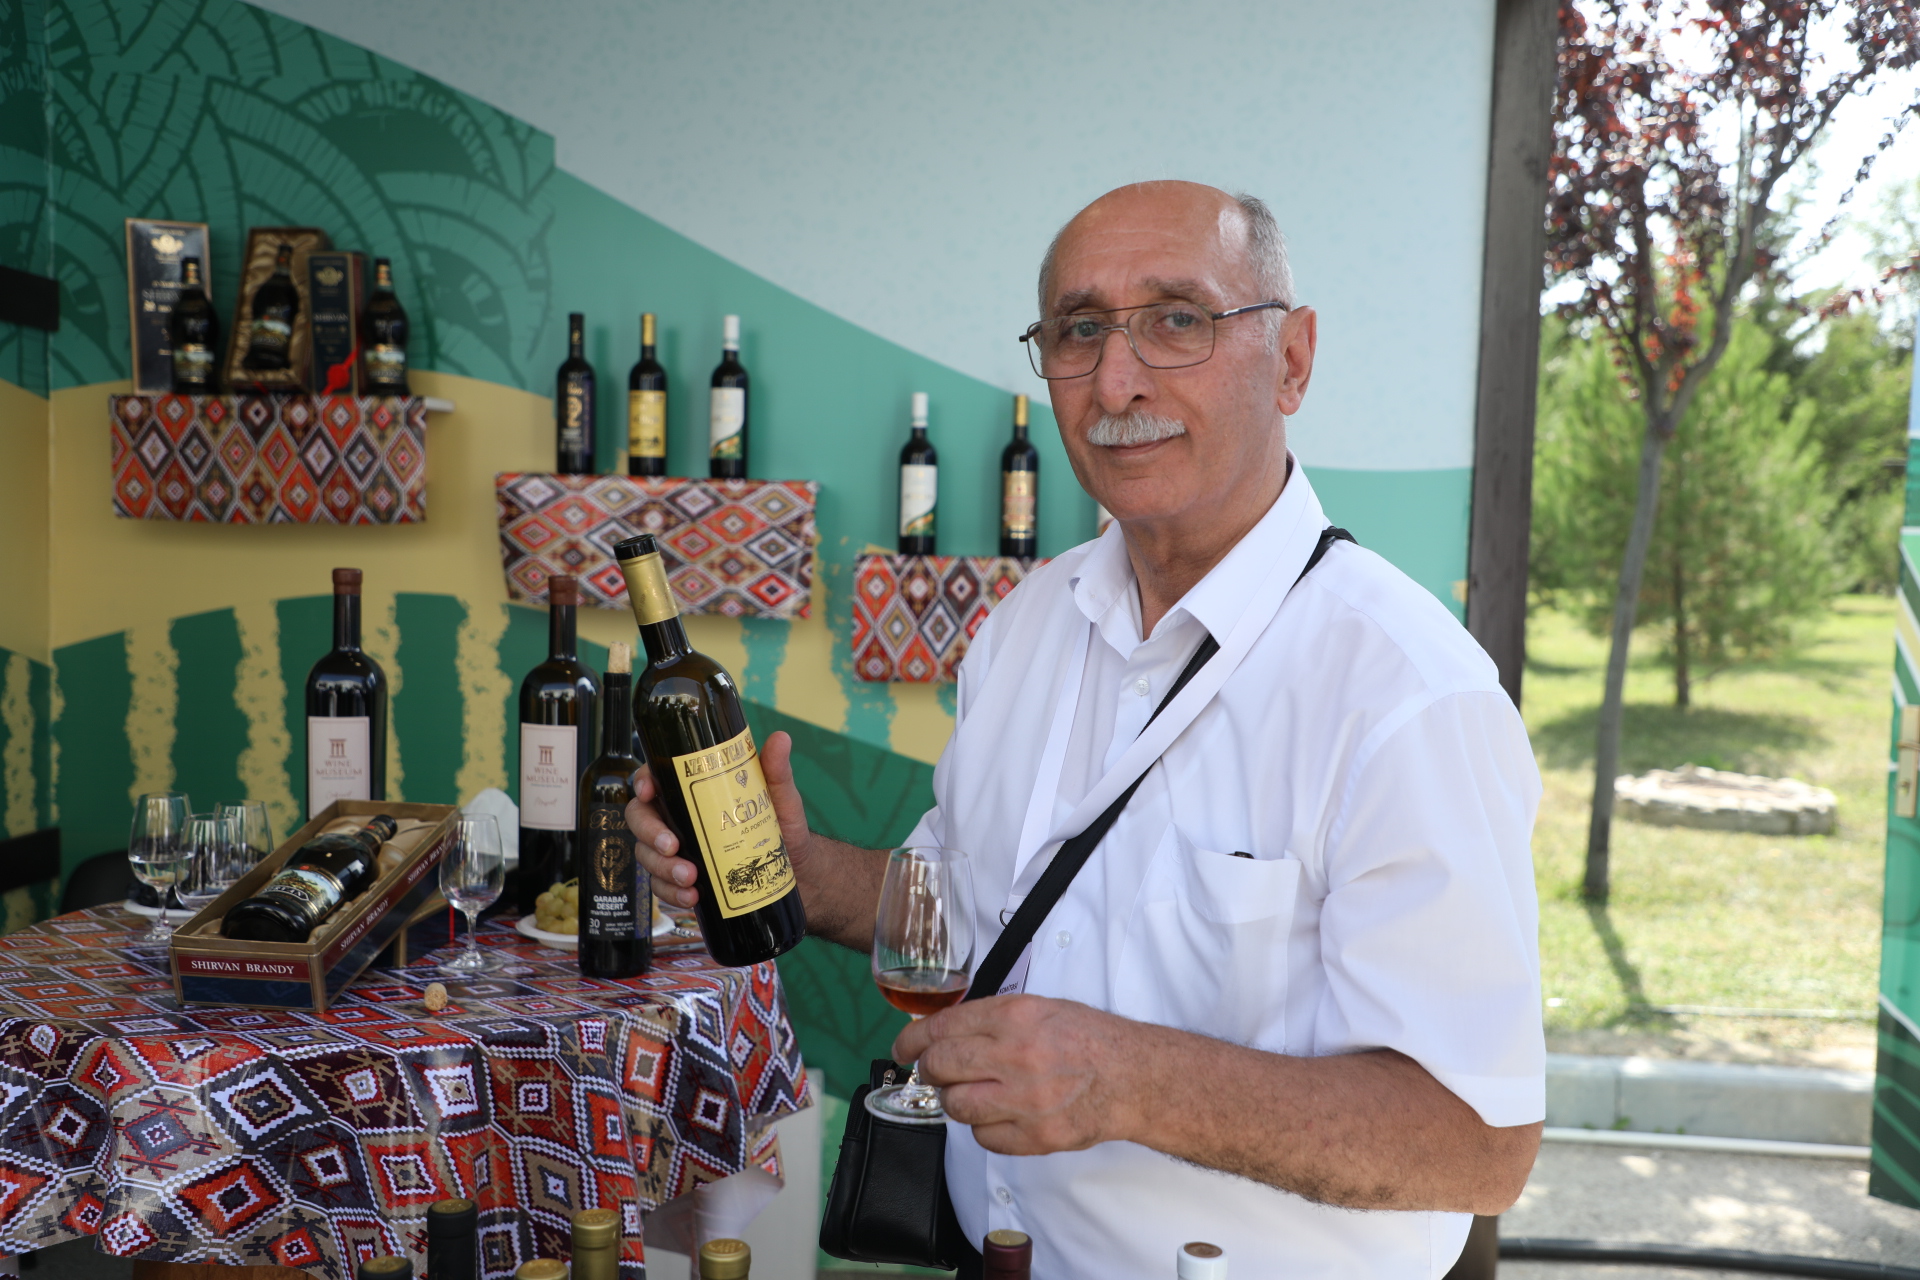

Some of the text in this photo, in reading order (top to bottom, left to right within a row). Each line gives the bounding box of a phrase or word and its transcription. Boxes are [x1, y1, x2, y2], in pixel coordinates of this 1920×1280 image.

[315, 767, 363, 776] MUSEUM
[534, 766, 559, 775] WINE
[526, 774, 569, 785] MUSEUM
[593, 894, 628, 903] QARABAĞ
[340, 897, 389, 951] SHIRVAN BRANDY
[589, 917, 600, 929] 30
[191, 960, 295, 975] SHIRVAN BRANDY
